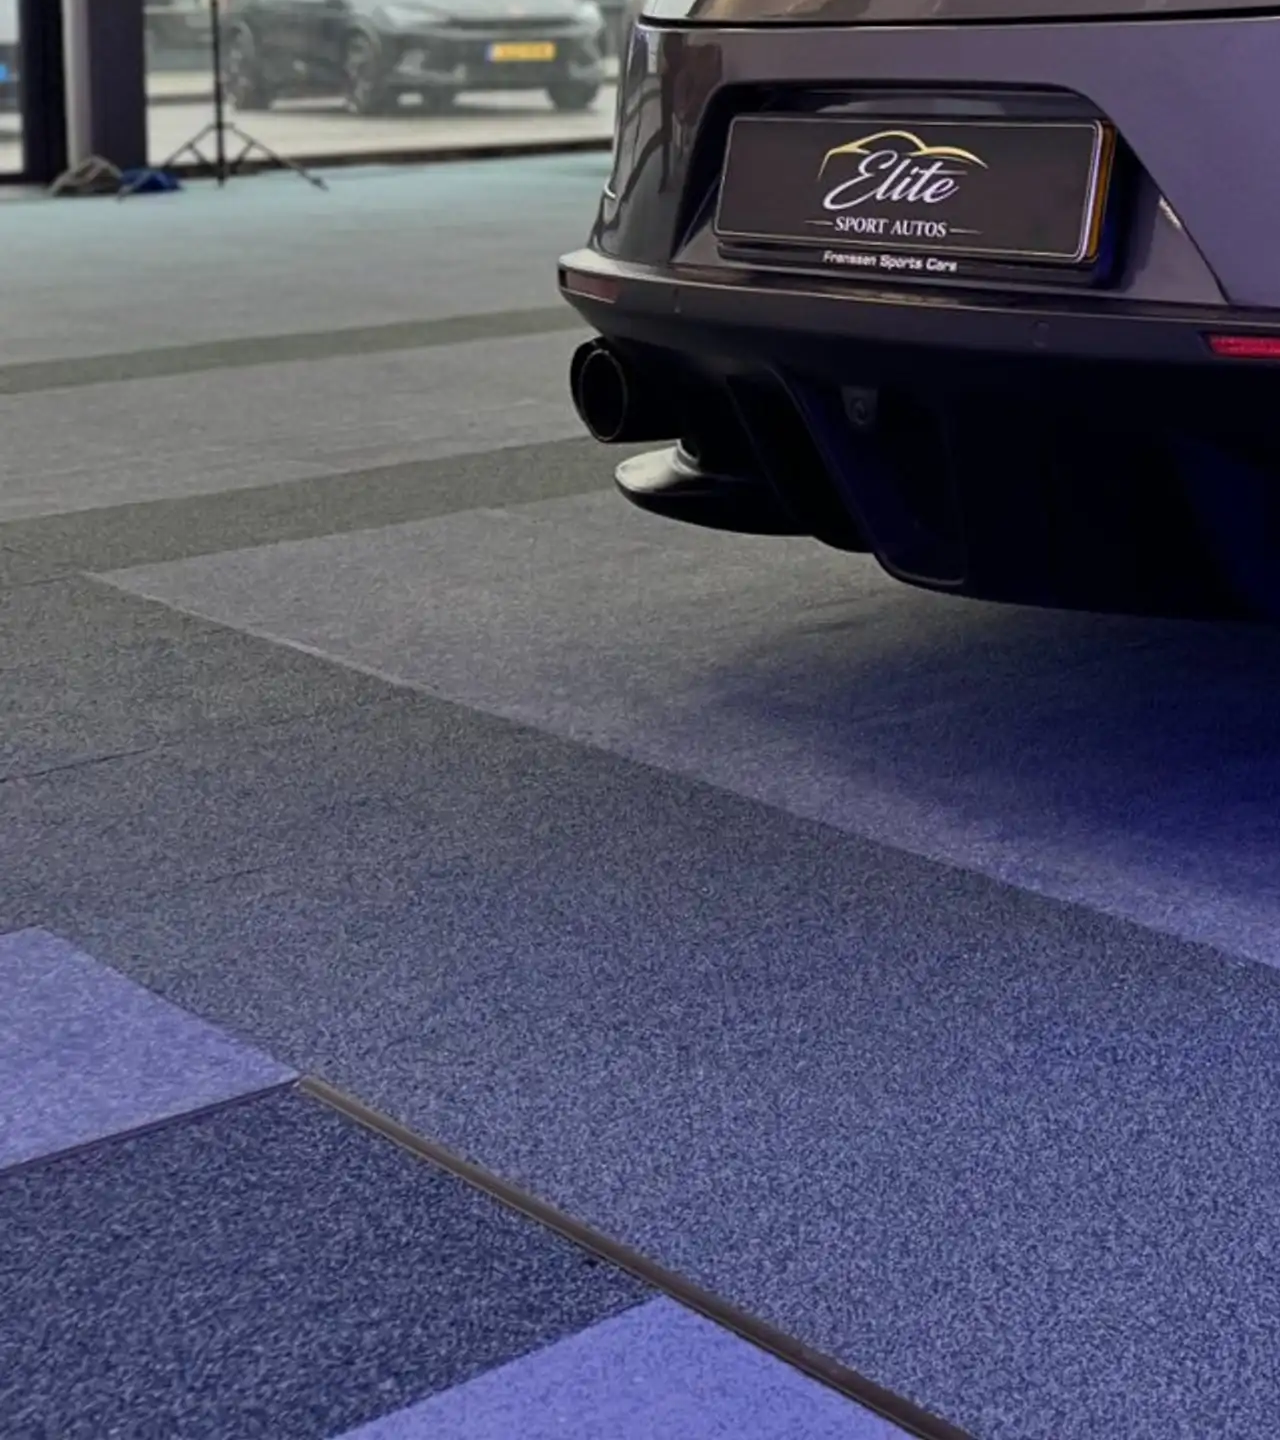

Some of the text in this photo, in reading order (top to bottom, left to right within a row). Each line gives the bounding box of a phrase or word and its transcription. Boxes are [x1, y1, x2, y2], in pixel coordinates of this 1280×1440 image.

[822, 149, 967, 211] Elite
[834, 216, 947, 238] SPORT AUTOS
[879, 253, 922, 271] Sports
[925, 257, 958, 273] Cars
